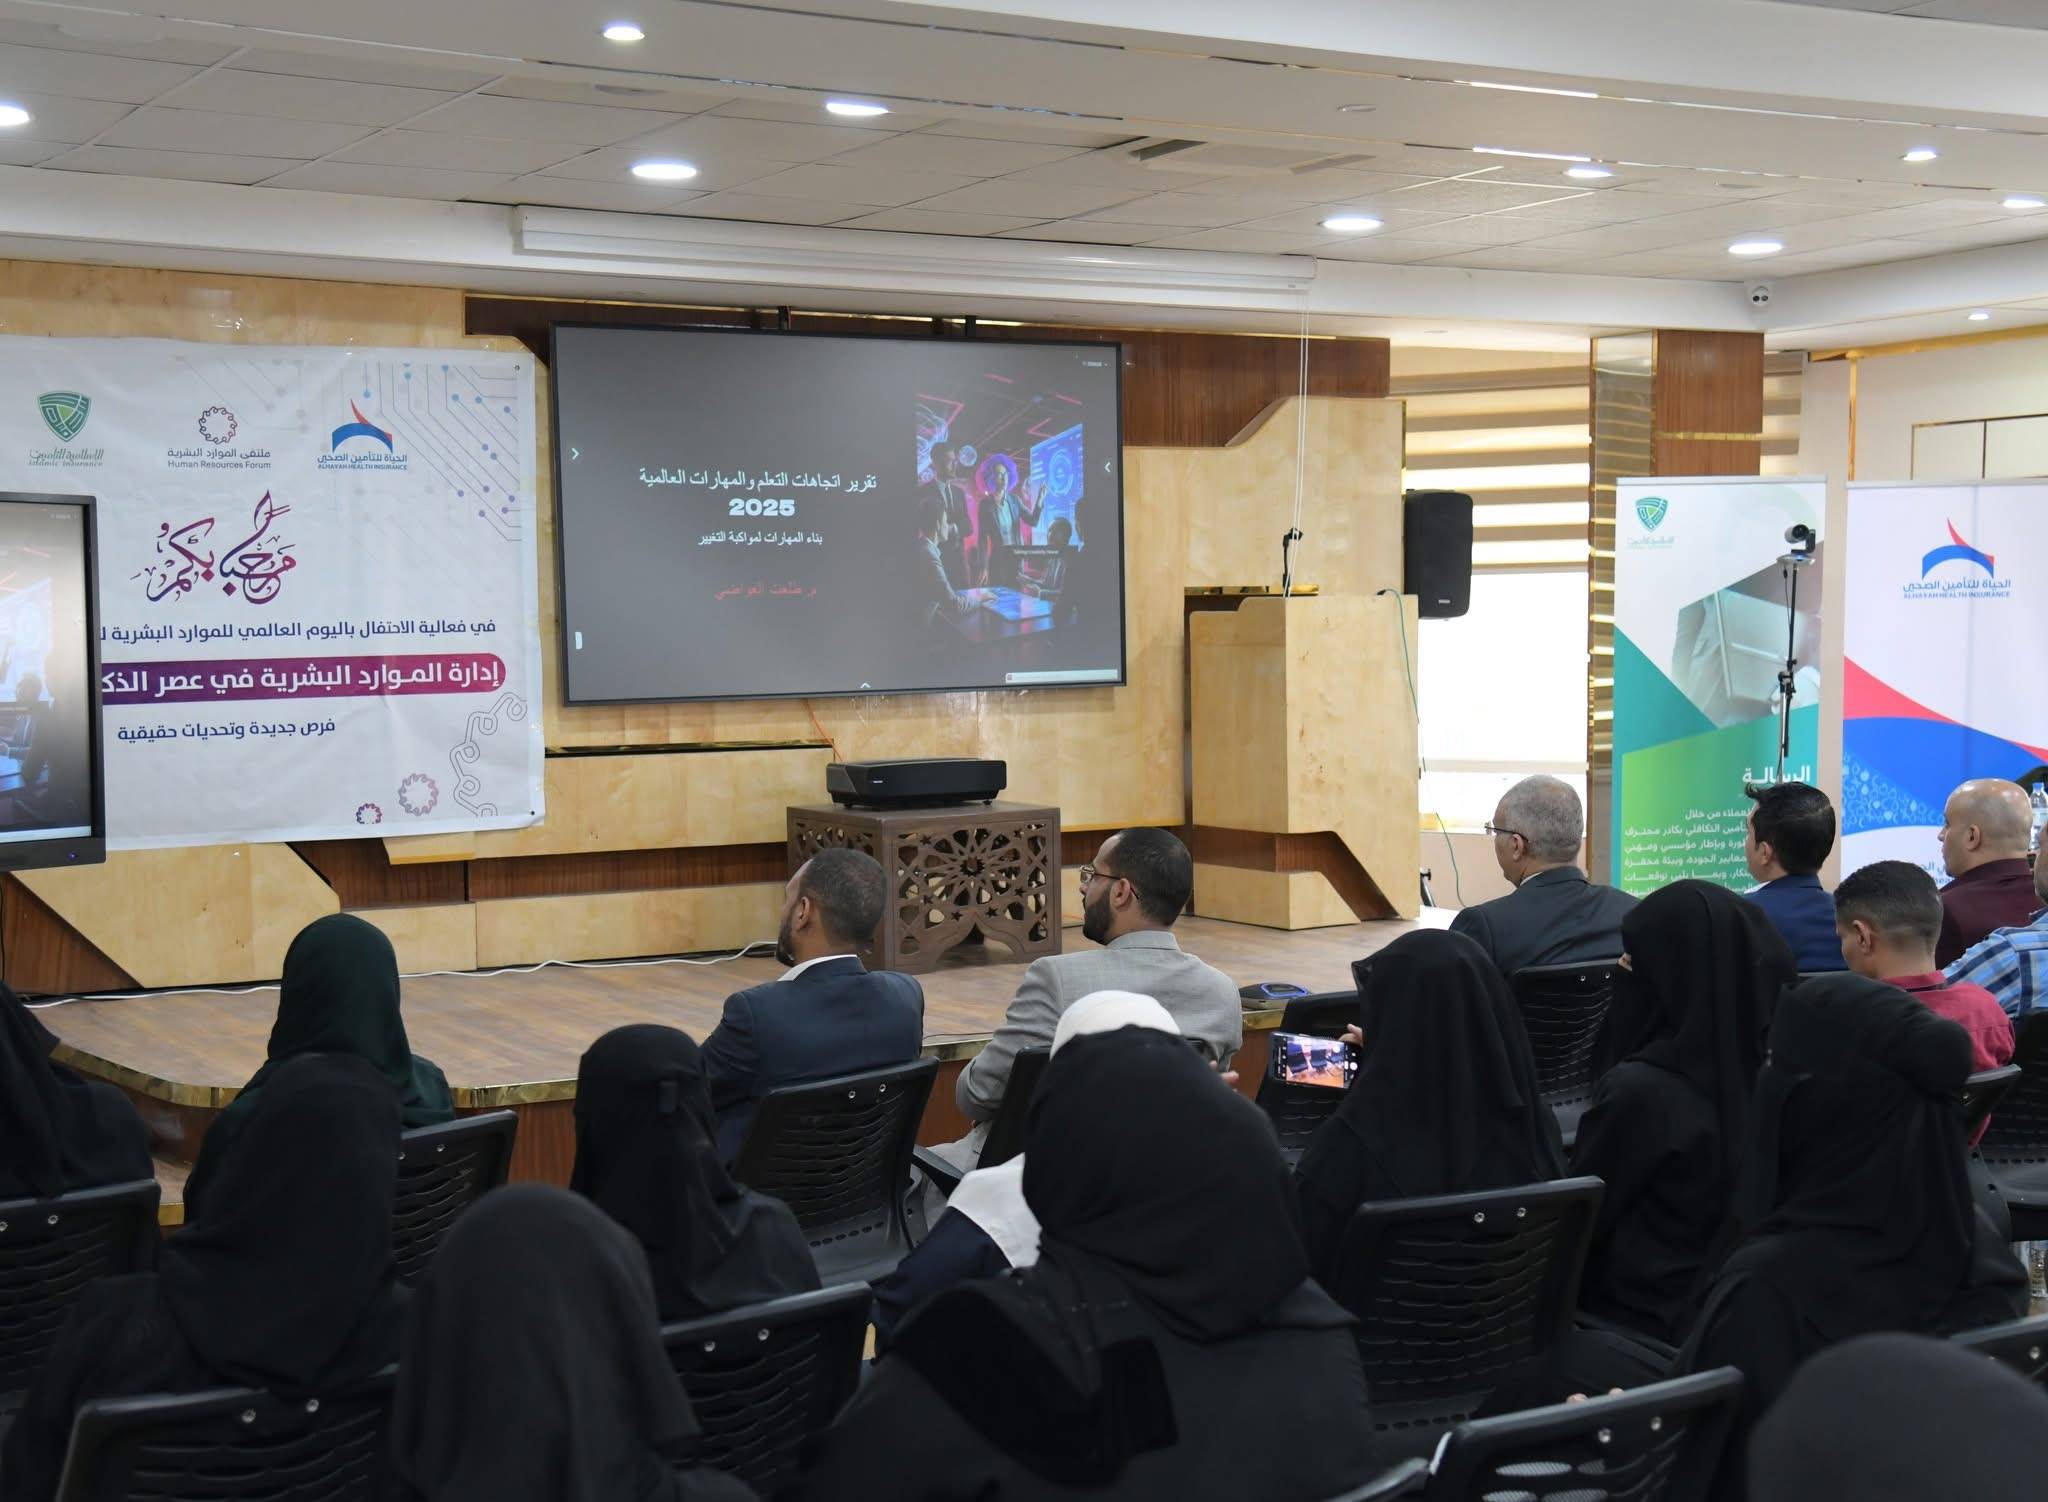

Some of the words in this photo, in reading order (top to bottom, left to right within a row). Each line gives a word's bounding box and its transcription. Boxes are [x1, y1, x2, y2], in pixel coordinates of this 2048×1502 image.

[168, 447, 203, 459] البشرية
[207, 448, 237, 459] الموارد
[240, 448, 271, 460] ملتقى
[317, 453, 348, 463] الصحي
[351, 451, 382, 463] للتأمين
[384, 453, 408, 464] الحياة
[168, 460, 199, 468] Human
[201, 460, 243, 468] Resources
[246, 460, 271, 468] Forum
[639, 467, 686, 487] العالمية
[757, 471, 788, 492] التعلم
[791, 471, 841, 492] اتجاهات
[845, 474, 877, 493] تقرير
[728, 498, 796, 517] 2025
[698, 530, 726, 546] التغيير
[728, 530, 763, 546] لمواكبة
[764, 531, 804, 546] المهارات
[806, 531, 823, 546] بناء
[1903, 580, 1940, 592] الصحي
[1942, 576, 1979, 591] للتأمين
[1982, 578, 2011, 590] الحياة
[112, 624, 173, 644] البشرية
[178, 624, 233, 643] للموارد
[238, 623, 301, 641] العالمي
[306, 621, 354, 640] باليوم
[360, 620, 414, 638] الاحتفال
[419, 620, 466, 637] فعالية
[470, 619, 496, 636] في
[101, 671, 148, 693] الذك
[210, 668, 254, 694] في
[260, 664, 351, 694] البشرية
[358, 663, 442, 690] الموارد
[449, 661, 500, 688] إدارة
[154, 675, 204, 697] عصر
[118, 725, 177, 743] حقيقية
[182, 721, 245, 740] وتحديات
[250, 721, 296, 738] جديدة
[301, 718, 336, 736] فرص
